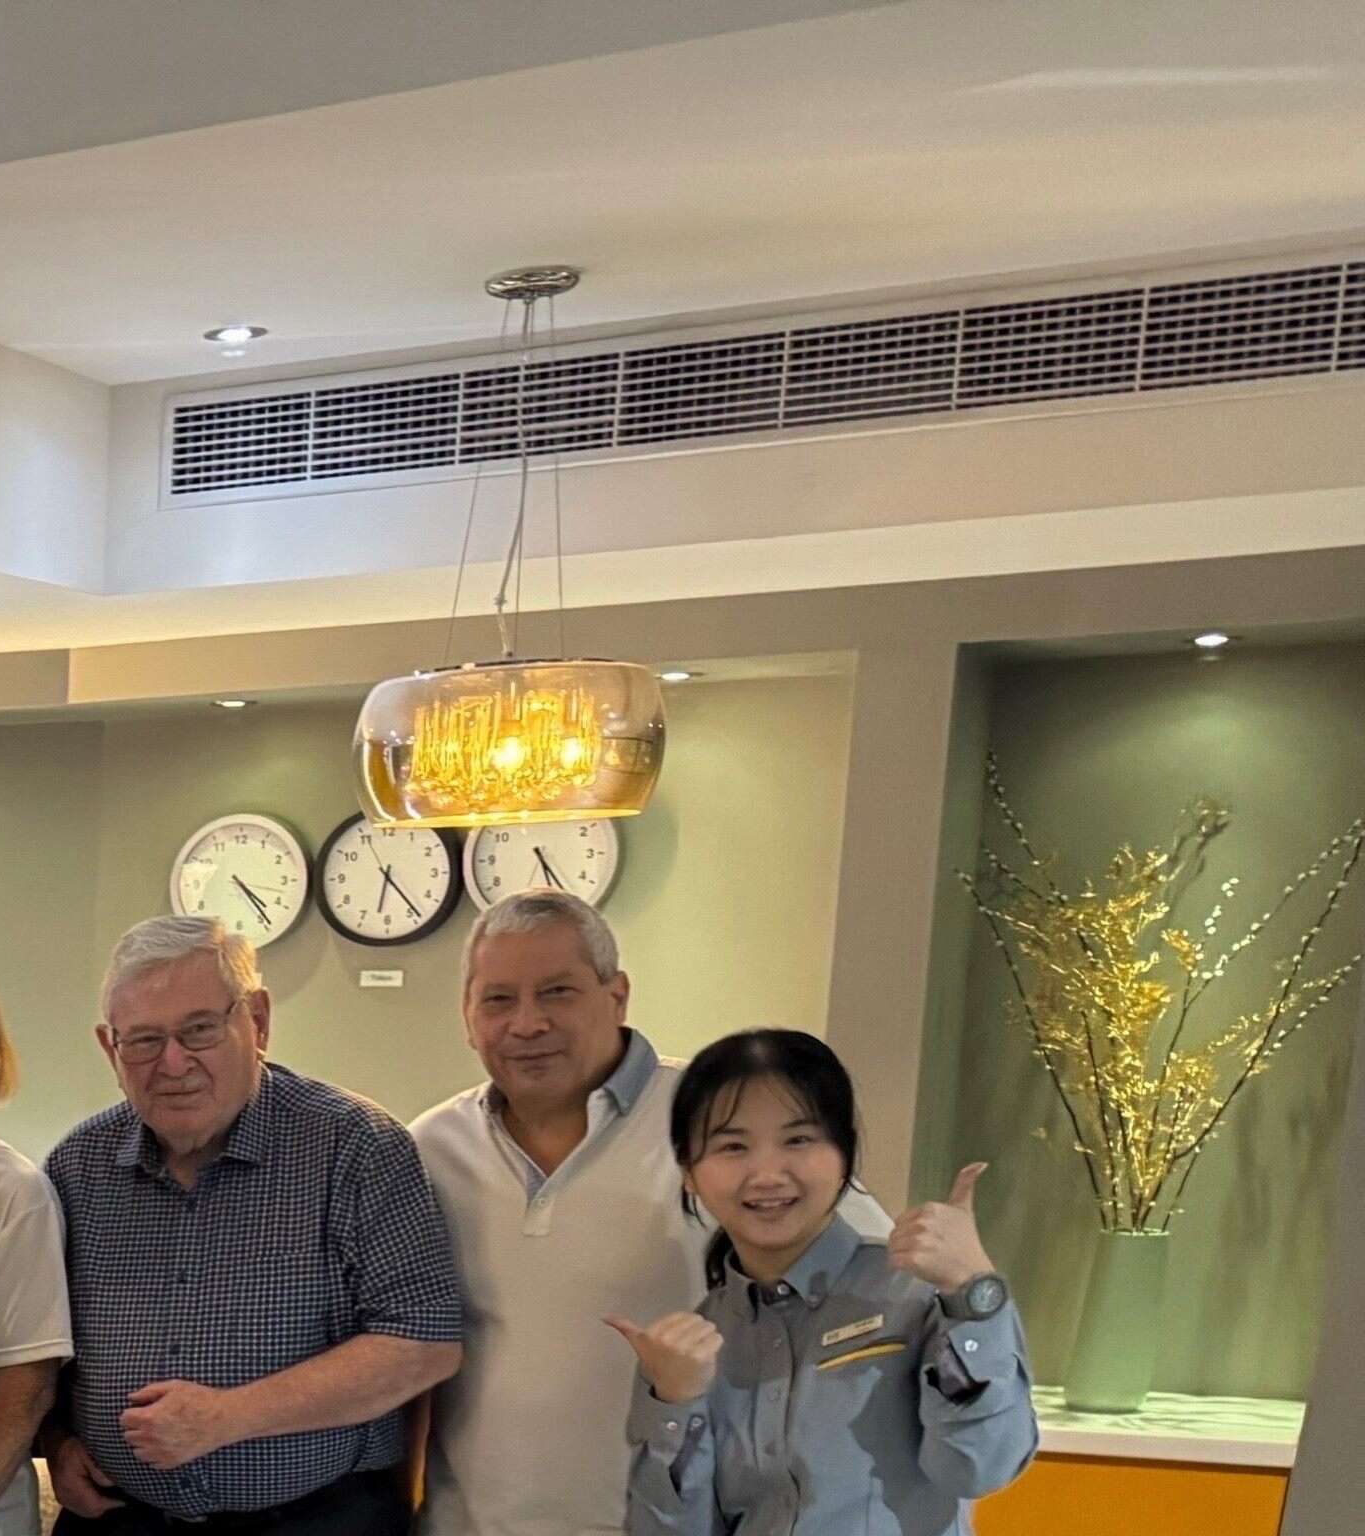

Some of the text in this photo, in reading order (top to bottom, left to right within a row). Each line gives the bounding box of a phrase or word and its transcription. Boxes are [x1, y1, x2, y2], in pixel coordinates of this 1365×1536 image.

[382, 827, 396, 837] 12
[495, 832, 509, 842] 10
[578, 826, 588, 837] 2
[234, 834, 248, 844] 12
[214, 842, 226, 852] 11
[424, 846, 432, 857] 2
[344, 851, 358, 862] 10
[586, 848, 594, 859] 3
[275, 854, 282, 865] 2
[488, 855, 496, 866] 9
[430, 867, 438, 878] 3
[578, 870, 586, 880] 4
[281, 875, 288, 886] 3
[337, 873, 346, 884] 9
[493, 876, 501, 887] 8
[343, 894, 351, 905] 8
[424, 889, 431, 899] 4
[275, 896, 282, 906] 4
[359, 910, 367, 920] 7
[383, 915, 391, 926] 6
